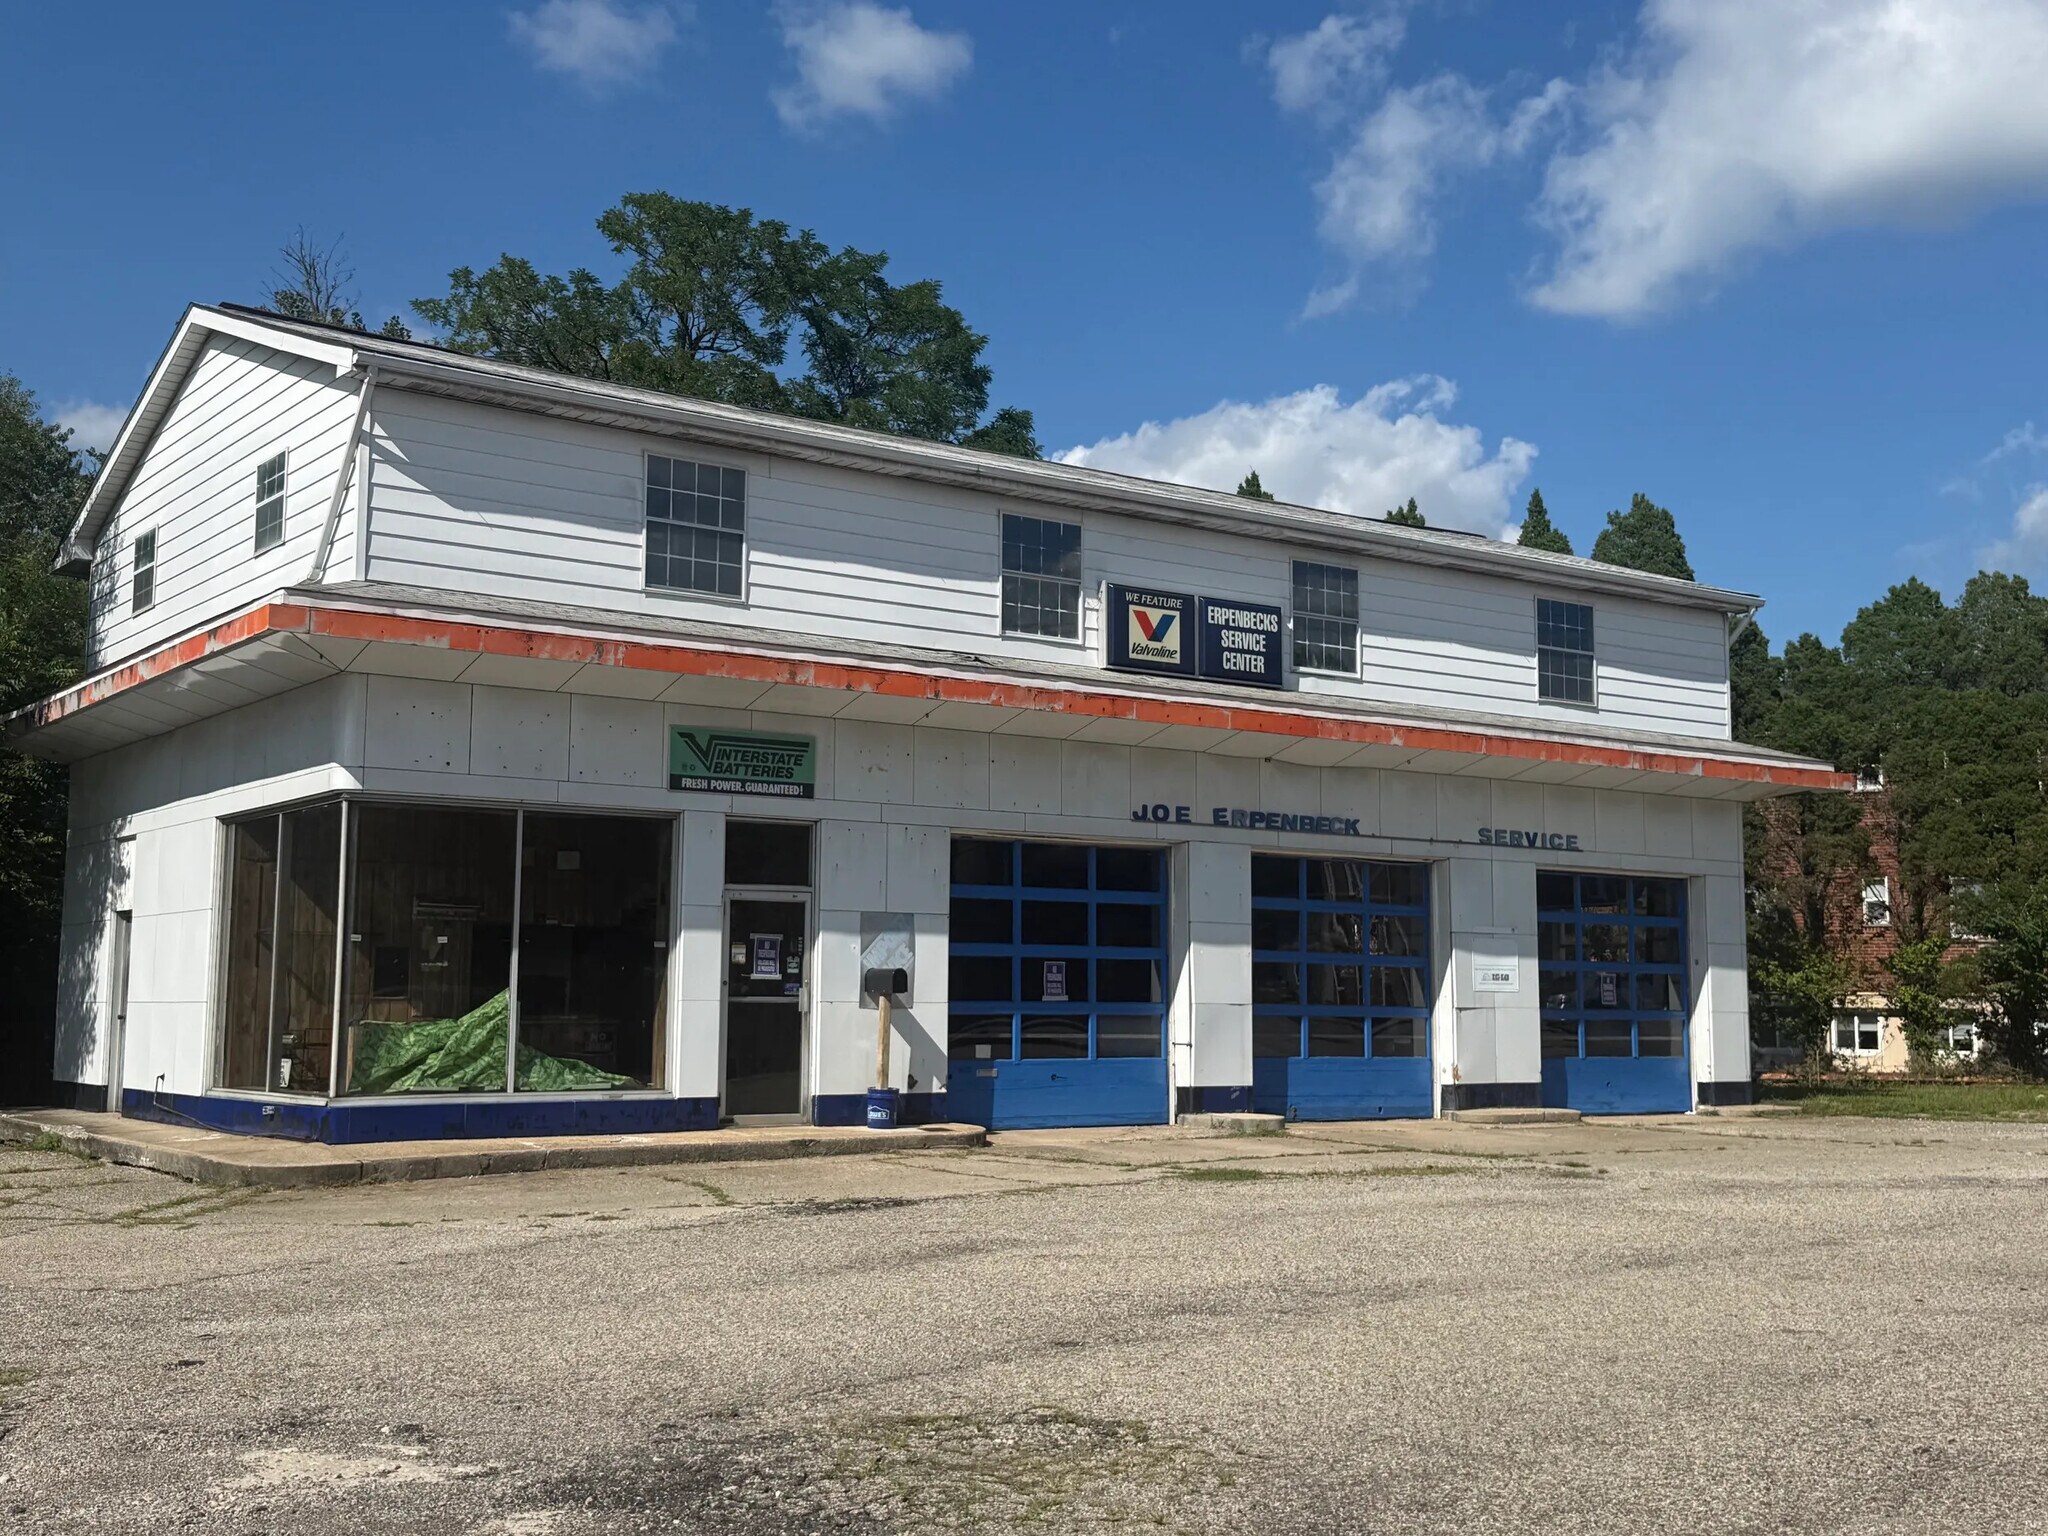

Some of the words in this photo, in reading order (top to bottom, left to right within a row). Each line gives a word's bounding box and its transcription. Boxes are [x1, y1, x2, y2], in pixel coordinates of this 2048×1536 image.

[1125, 592, 1140, 603] WE
[1141, 594, 1183, 609] FEATURE
[1207, 605, 1278, 633] ERPENBECKS
[1131, 642, 1178, 659] Valvoline
[1221, 629, 1266, 652] SERVICE
[1223, 651, 1265, 674] CENTER
[716, 749, 804, 766] INTERSTATE
[713, 762, 794, 779] BATTERIES
[681, 777, 708, 790] FRESH
[710, 780, 745, 792] POWER.
[745, 782, 804, 796] GUARANTEED!
[1132, 804, 1192, 823] JOE
[1212, 807, 1361, 836] ERPENBECK
[1478, 827, 1580, 850] SERVICE
